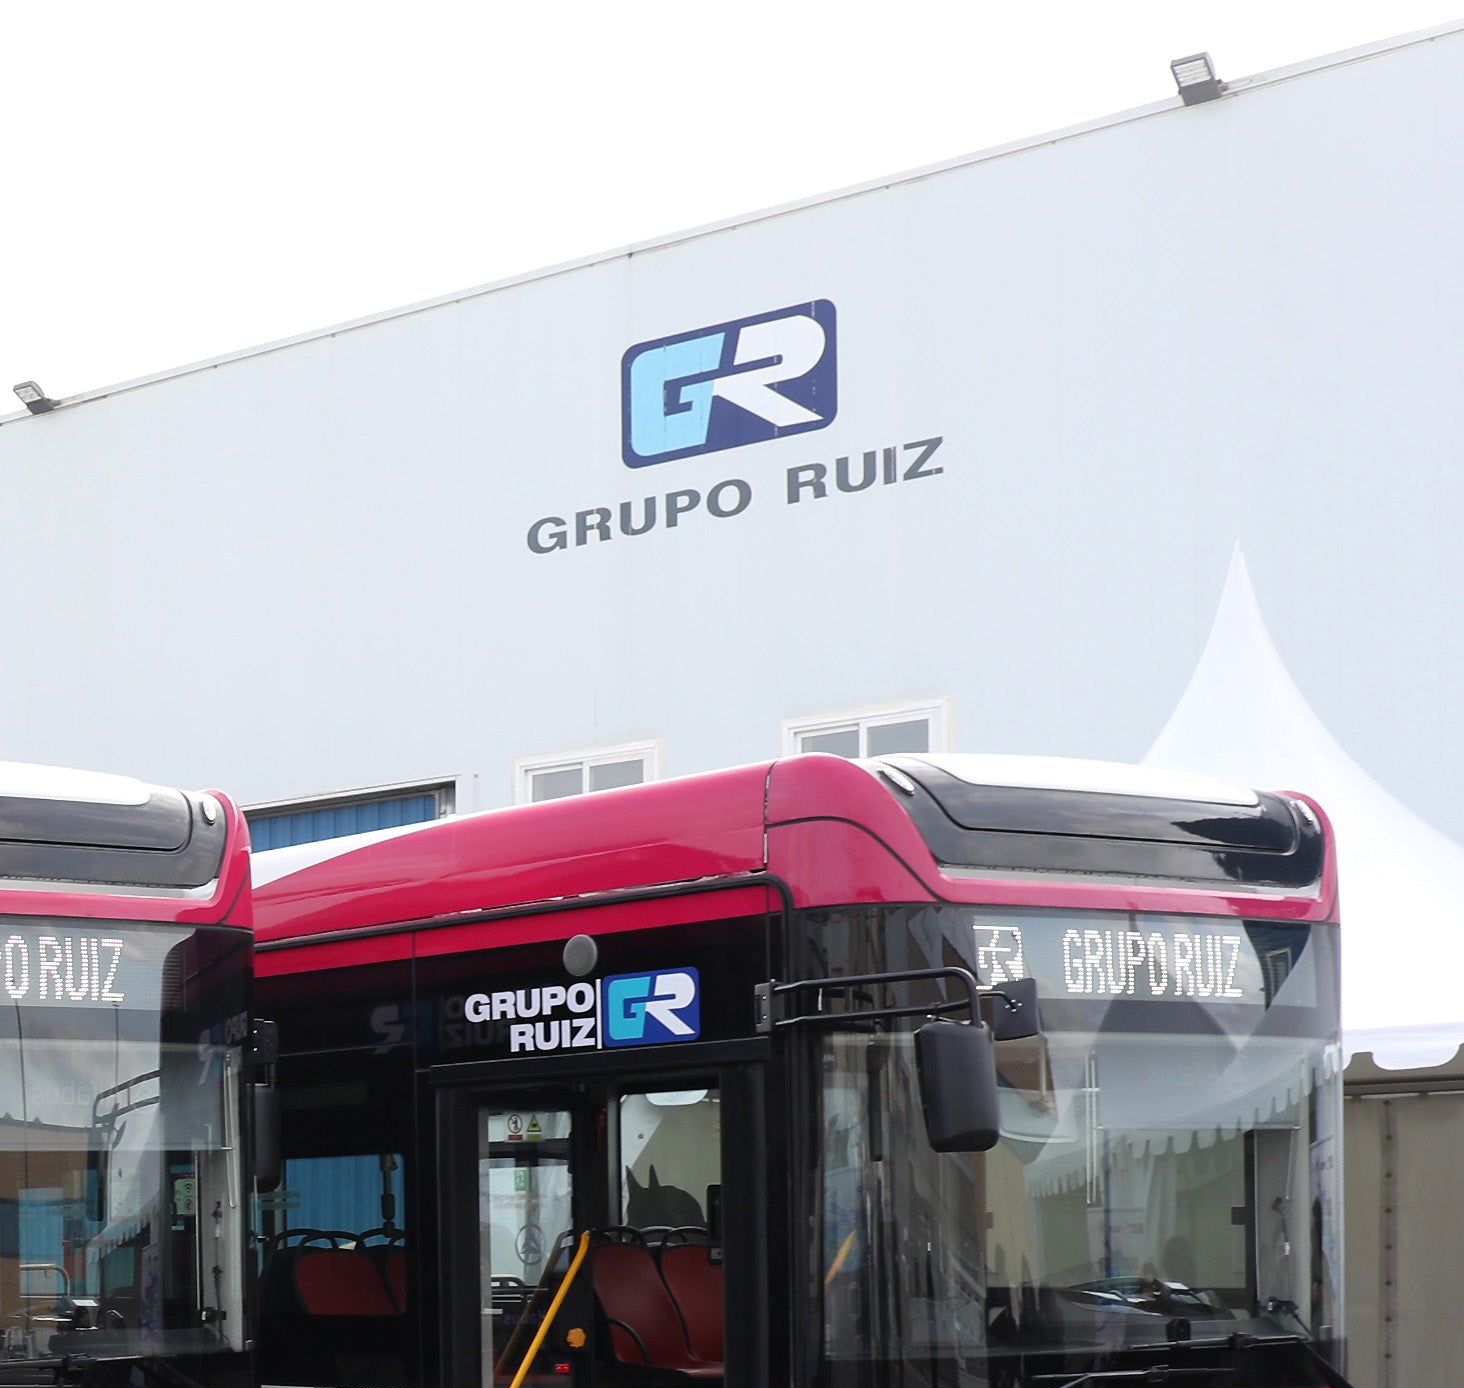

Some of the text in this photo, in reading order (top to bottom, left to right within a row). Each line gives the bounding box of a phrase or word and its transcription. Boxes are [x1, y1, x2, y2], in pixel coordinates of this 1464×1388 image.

[630, 313, 827, 457] GR
[526, 436, 945, 555] GRUPO RUIZ
[38, 936, 125, 1002] RUIZ
[1062, 928, 1244, 998] GRUPO RUIZ
[464, 982, 595, 1023] GRUPO
[509, 1018, 596, 1052] RUIZ
[607, 972, 697, 1041] GR
